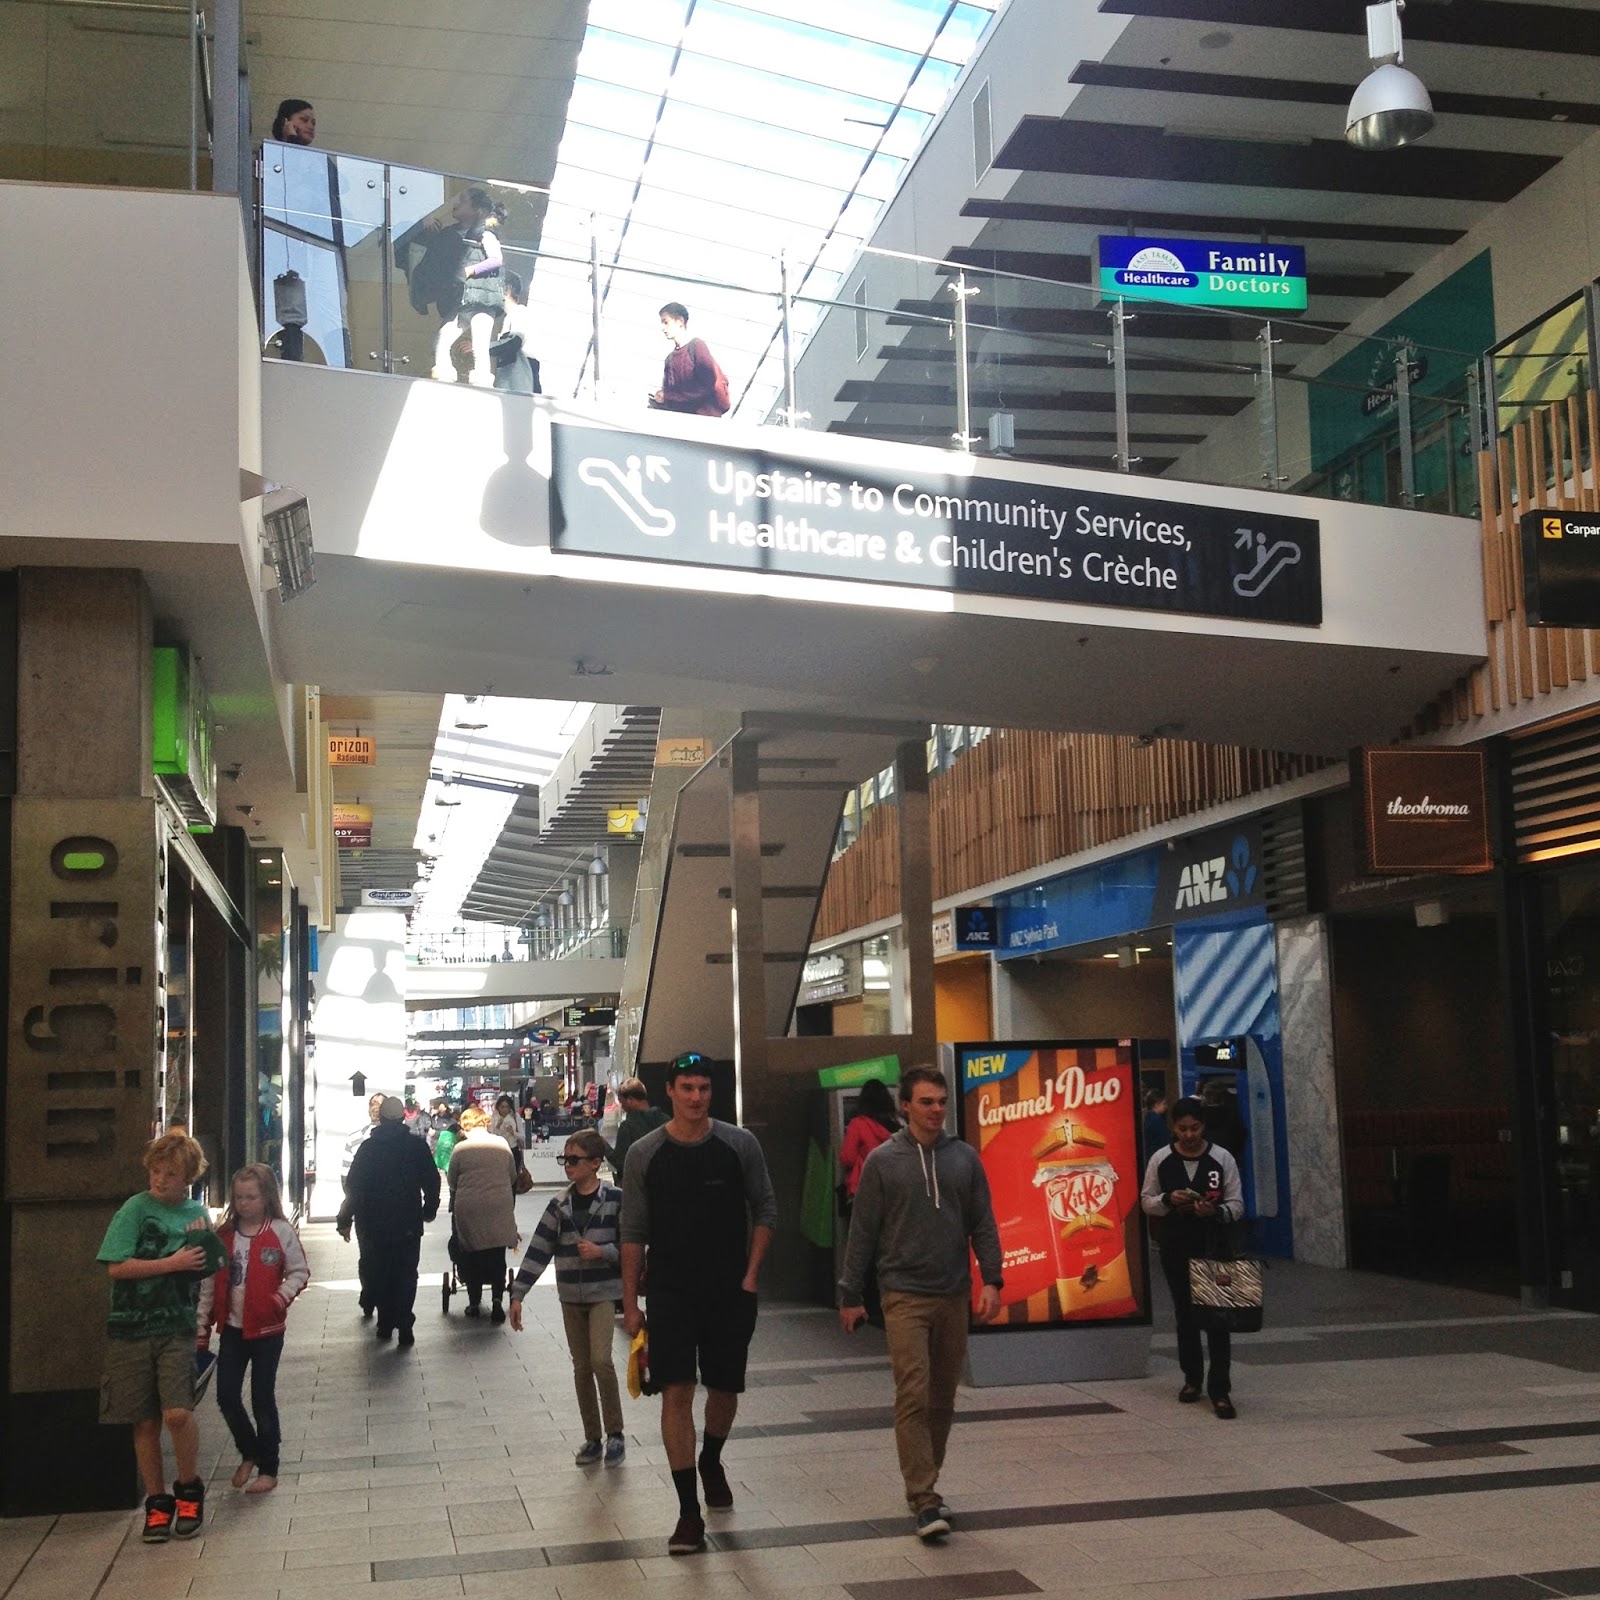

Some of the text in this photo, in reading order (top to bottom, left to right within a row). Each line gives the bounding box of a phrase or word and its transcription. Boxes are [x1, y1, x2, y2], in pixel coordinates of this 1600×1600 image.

[1209, 251, 1290, 277] Family
[1123, 272, 1190, 286] Healthcare
[1209, 275, 1290, 294] Doctors
[707, 459, 1192, 552] Upstairs to Community Services,
[709, 509, 1178, 590] Healthcare & Children's Crèche
[337, 753, 369, 764] Radiology
[1386, 795, 1470, 815] theobroma
[1175, 856, 1228, 910] ANZ
[966, 931, 990, 941] ANZ
[1043, 922, 1059, 940] Park
[967, 1053, 1007, 1078] NEW
[978, 1066, 1121, 1127] Caramel Duo
[1207, 1170, 1220, 1189] 3
